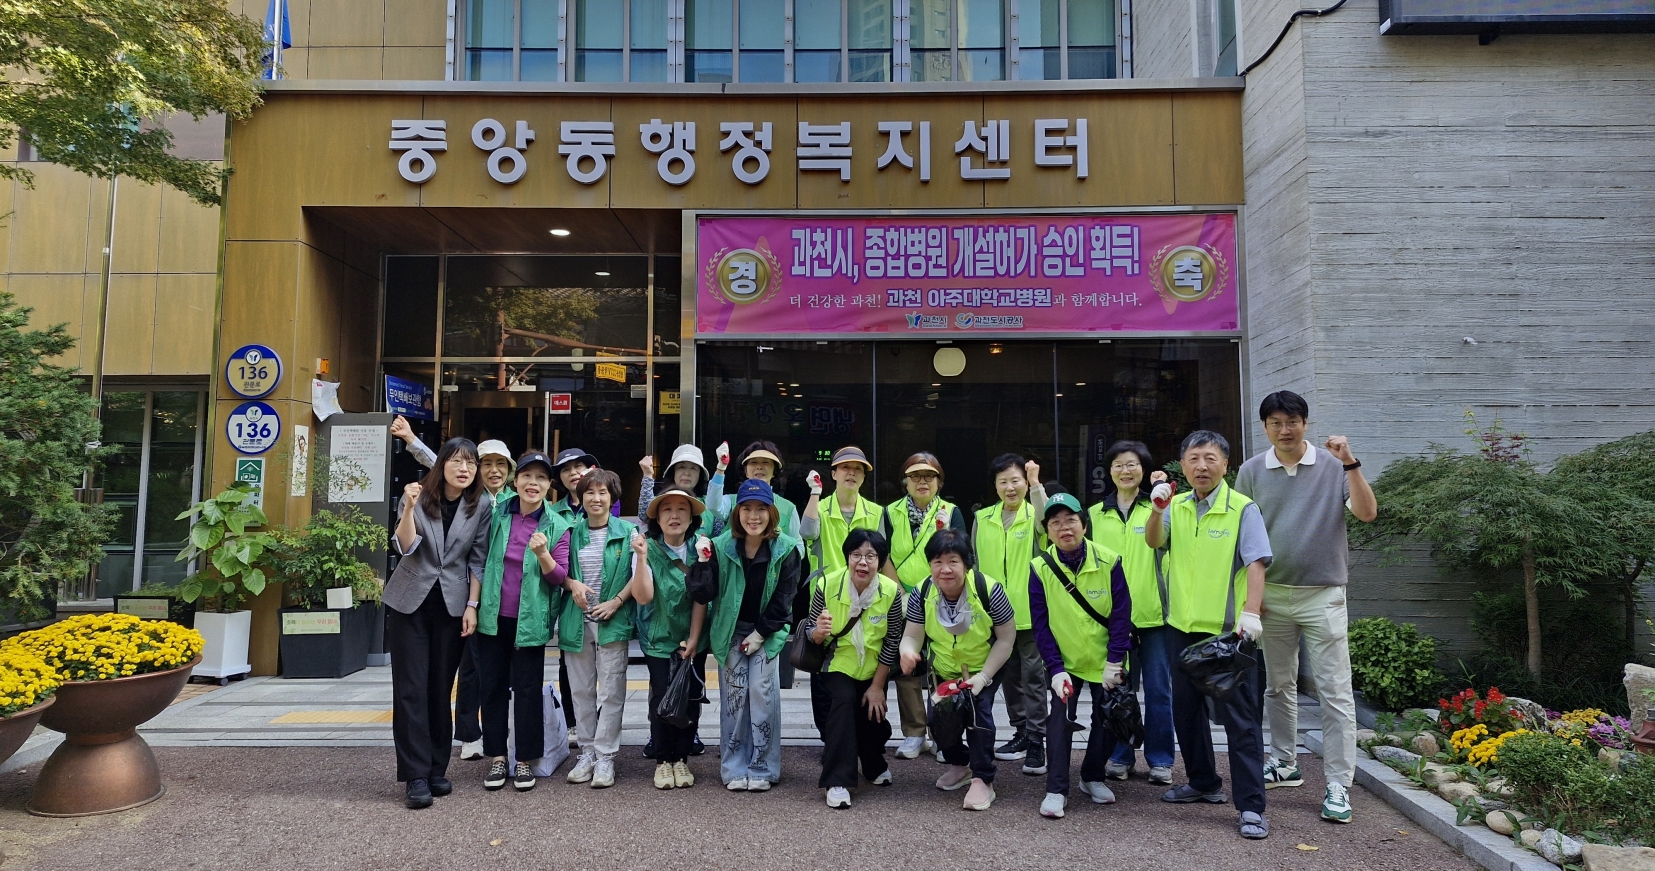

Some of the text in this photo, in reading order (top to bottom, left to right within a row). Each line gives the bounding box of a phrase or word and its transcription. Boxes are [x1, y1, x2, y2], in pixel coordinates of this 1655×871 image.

[389, 117, 1089, 185] 중앙동행정복지센터
[791, 225, 1140, 283] 과천시, 종합병원 개설허가 승인 획득!
[729, 261, 757, 294] 경
[1173, 257, 1204, 291] 축
[790, 295, 801, 308] 더
[807, 294, 847, 309] 건강한
[851, 294, 882, 308] 과천!
[887, 289, 922, 307] 과천
[1071, 292, 1143, 307] 함께합니다.
[923, 316, 947, 324] 과천시
[974, 316, 1022, 324] 과천도시공사
[239, 366, 268, 380] 136
[236, 422, 271, 438] 136
